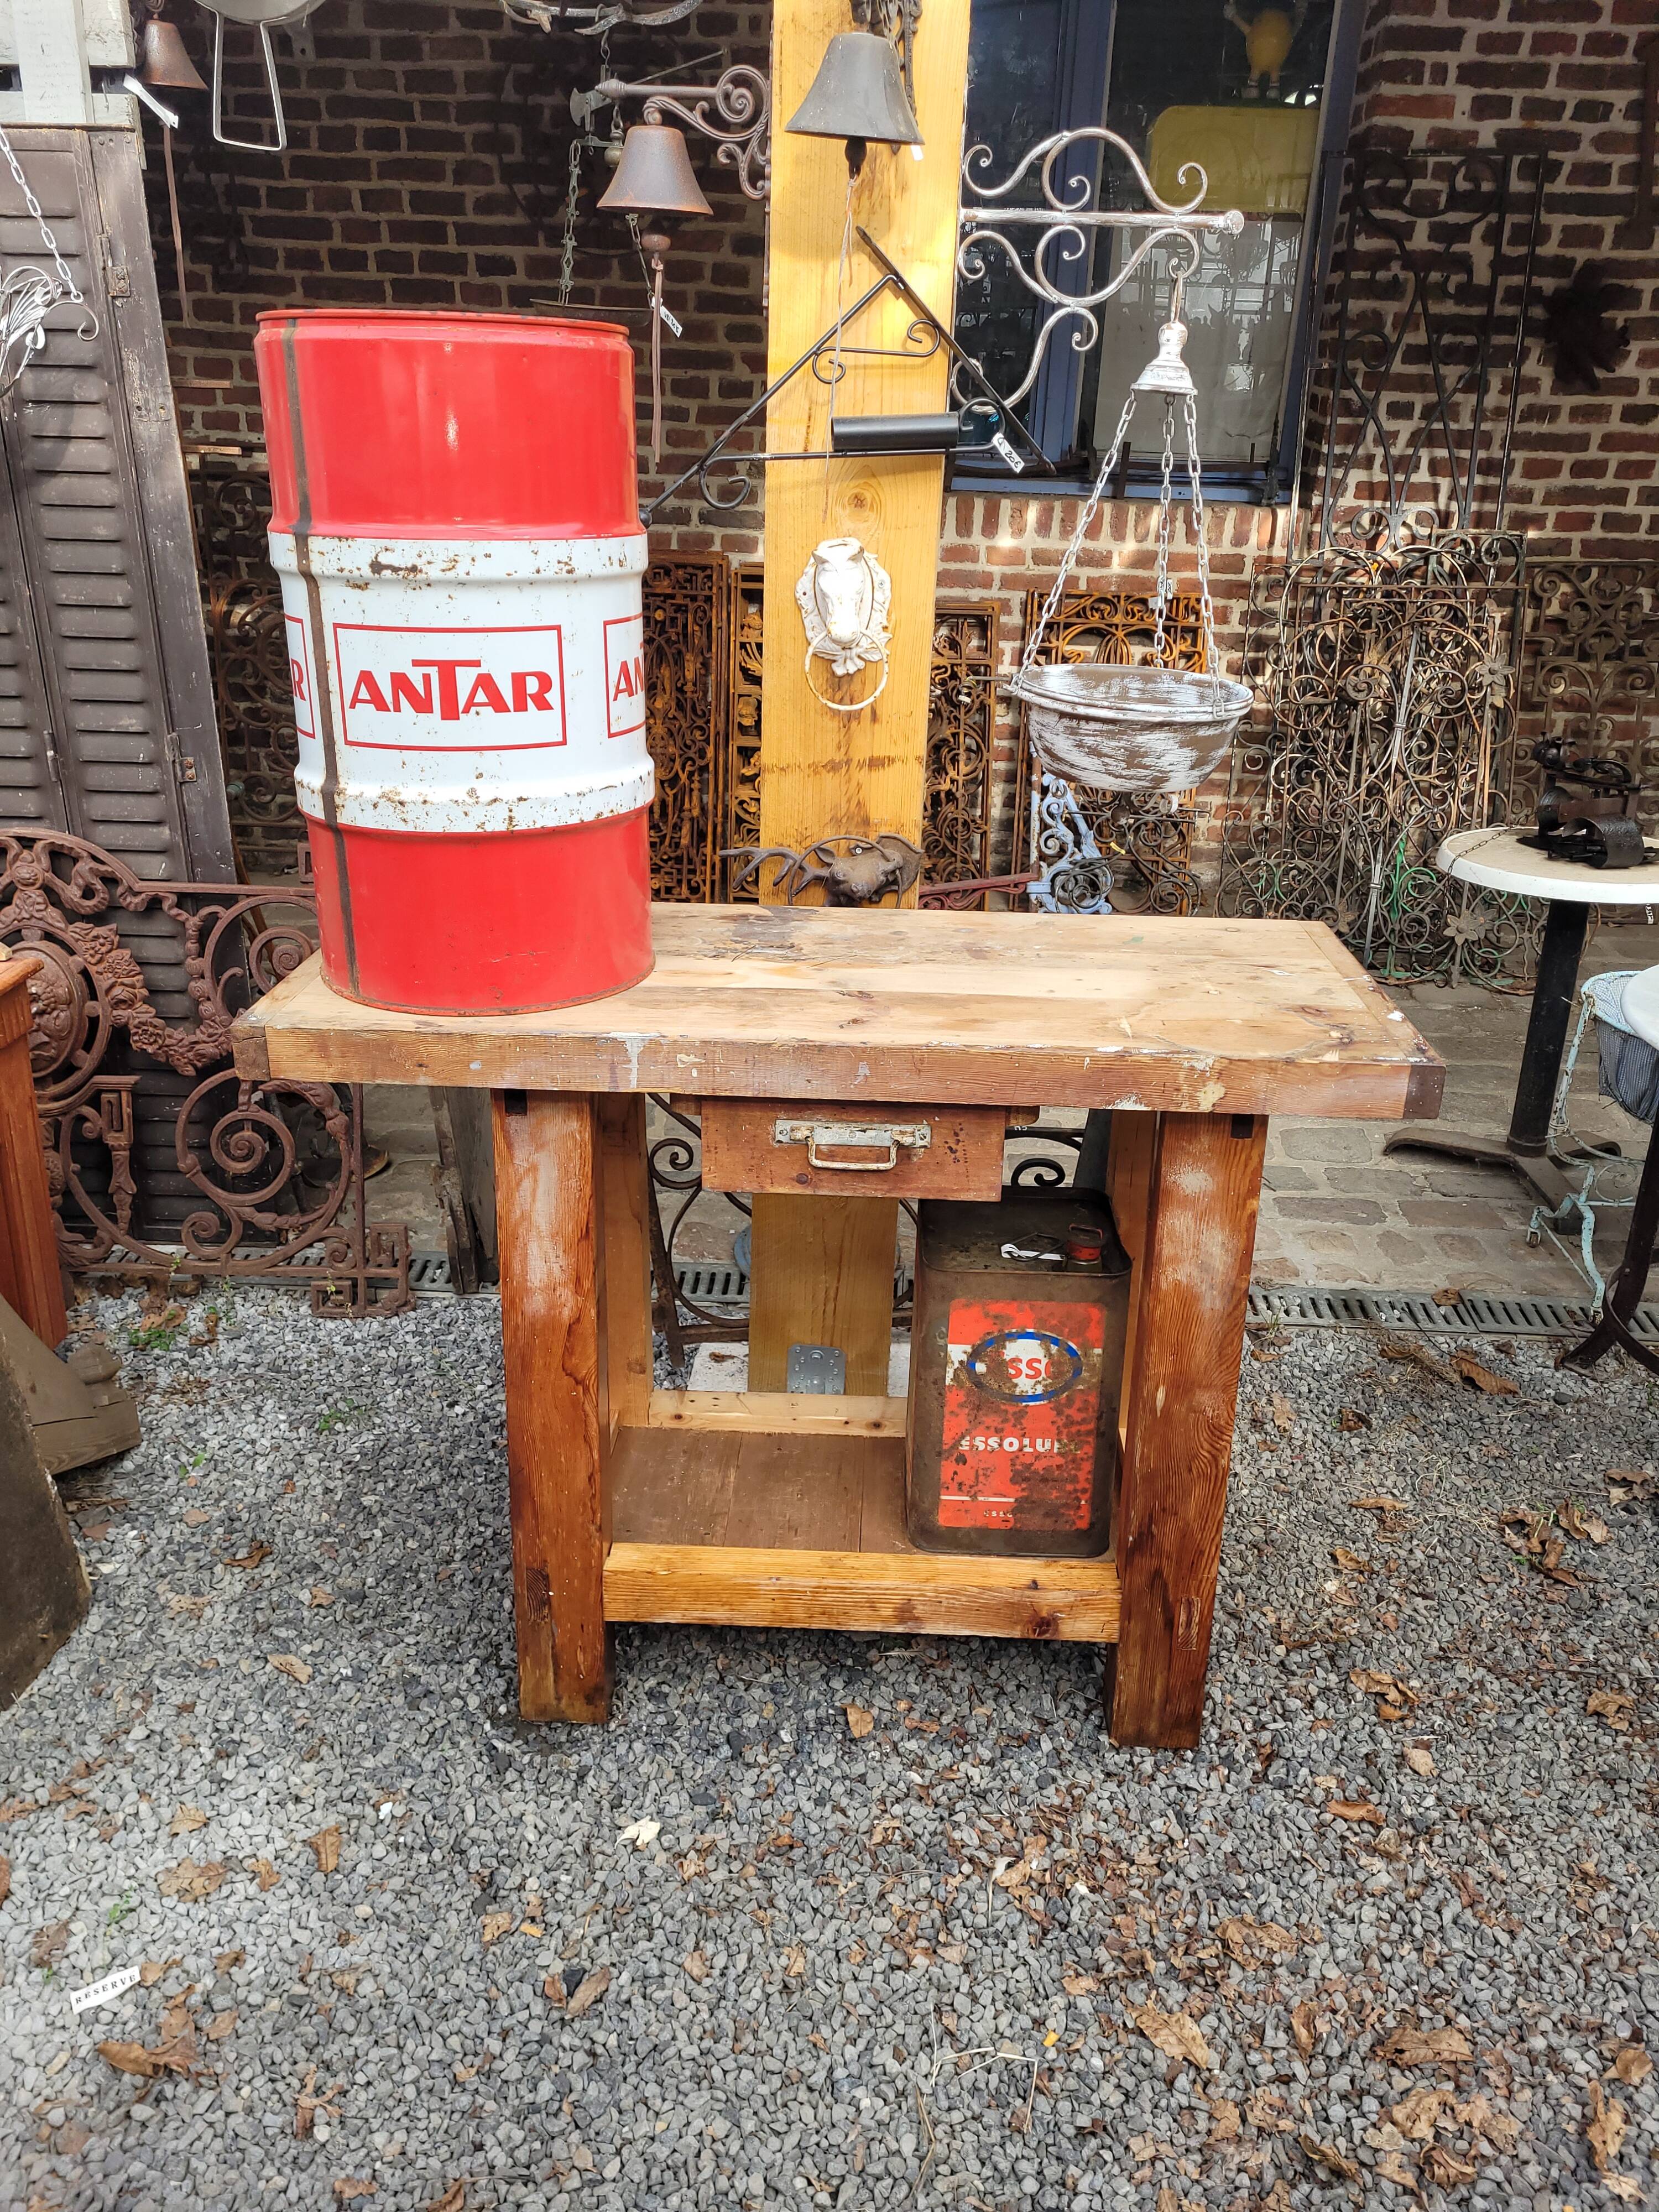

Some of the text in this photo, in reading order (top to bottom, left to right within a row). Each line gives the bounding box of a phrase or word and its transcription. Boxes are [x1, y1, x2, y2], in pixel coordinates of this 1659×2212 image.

[1004, 450, 1021, 468] 20€
[348, 659, 555, 721] ANTAR
[75, 1974, 136, 2005] RESERVE
